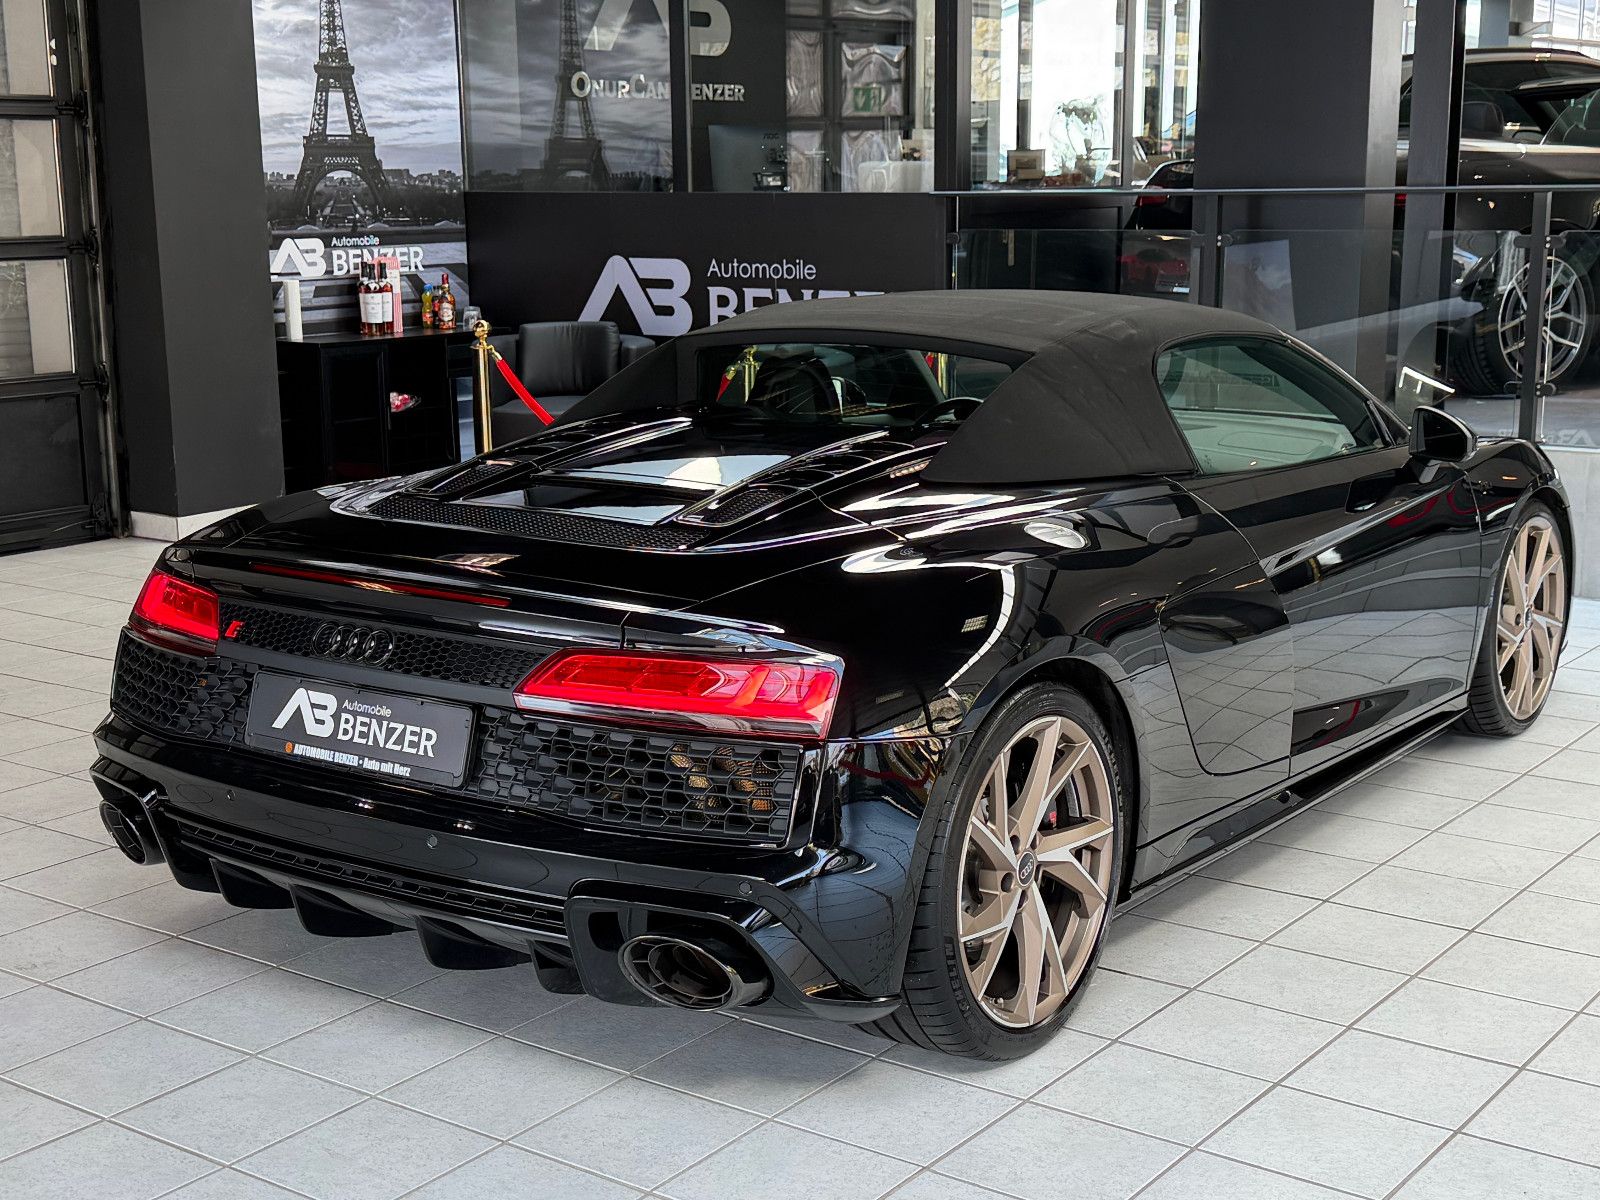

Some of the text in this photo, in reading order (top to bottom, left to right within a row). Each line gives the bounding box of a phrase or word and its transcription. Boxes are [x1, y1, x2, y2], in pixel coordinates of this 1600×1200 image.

[691, 83, 745, 101] ENZER
[270, 237, 327, 277] AB
[331, 234, 379, 247] Automobile
[707, 258, 817, 280] Automobile
[577, 254, 693, 337] AB
[271, 687, 338, 738] AB
[342, 699, 392, 718] Automobile
[337, 713, 438, 757] BENZER
[293, 743, 411, 777] AUTOMOBILE BENZER Auto mit Herz
